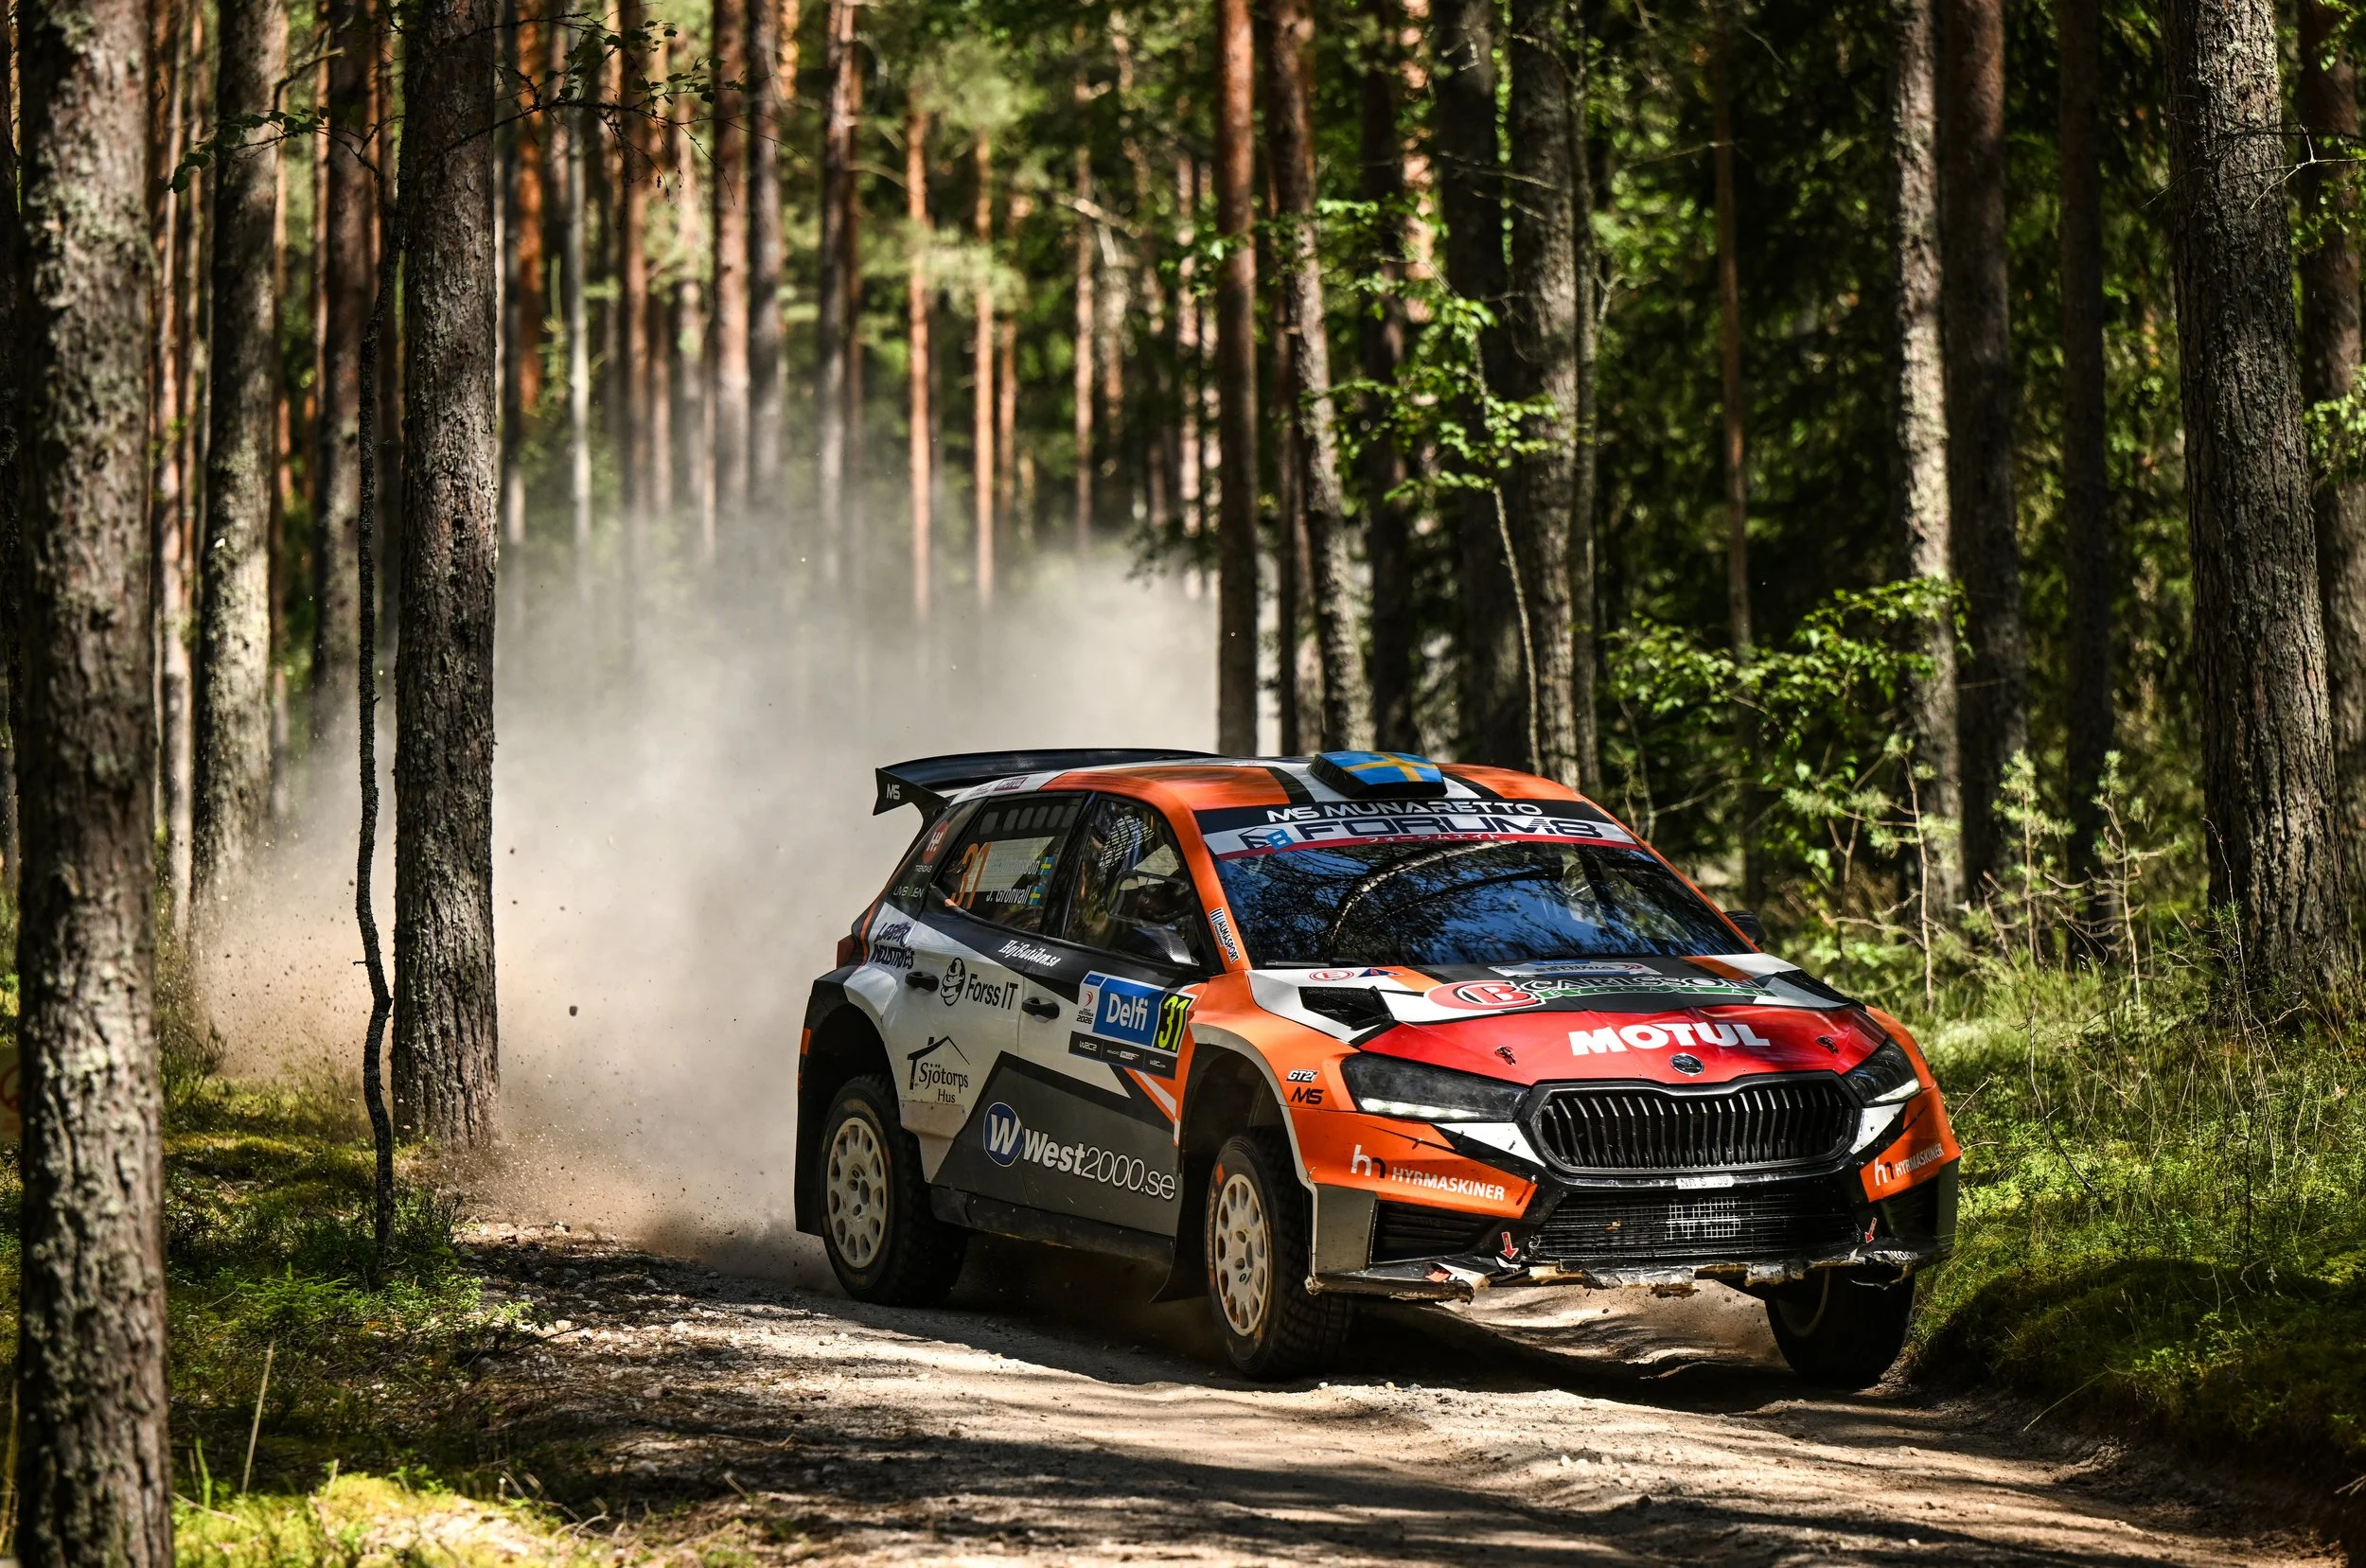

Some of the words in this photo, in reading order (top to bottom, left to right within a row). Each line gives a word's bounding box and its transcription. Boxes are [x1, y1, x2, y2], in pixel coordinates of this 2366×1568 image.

[887, 784, 900, 800] MS
[1266, 805, 1321, 823] MS
[1324, 800, 1543, 818] MUNARETTO
[1294, 815, 1603, 840] FORUM8
[1366, 834, 1500, 843] フォーラムエイト
[1218, 921, 1239, 962] ALMASPORT
[965, 973, 1001, 1006] Forss
[1001, 981, 1018, 1011] IT
[1520, 976, 1763, 991] CARLSSON
[1076, 1015, 1093, 1025] 2026
[1105, 994, 1148, 1031] Delfi
[1157, 995, 1190, 1051] 31
[1568, 1022, 1770, 1055] MOTUL
[918, 1062, 969, 1093] Sjötorps
[937, 1088, 956, 1103] Hus
[1291, 1086, 1325, 1104] MS
[1023, 1127, 1175, 1200] West2000.se
[1894, 1142, 1945, 1178] HYRMASKINER
[1391, 1166, 1506, 1201] HYRMASKINER
